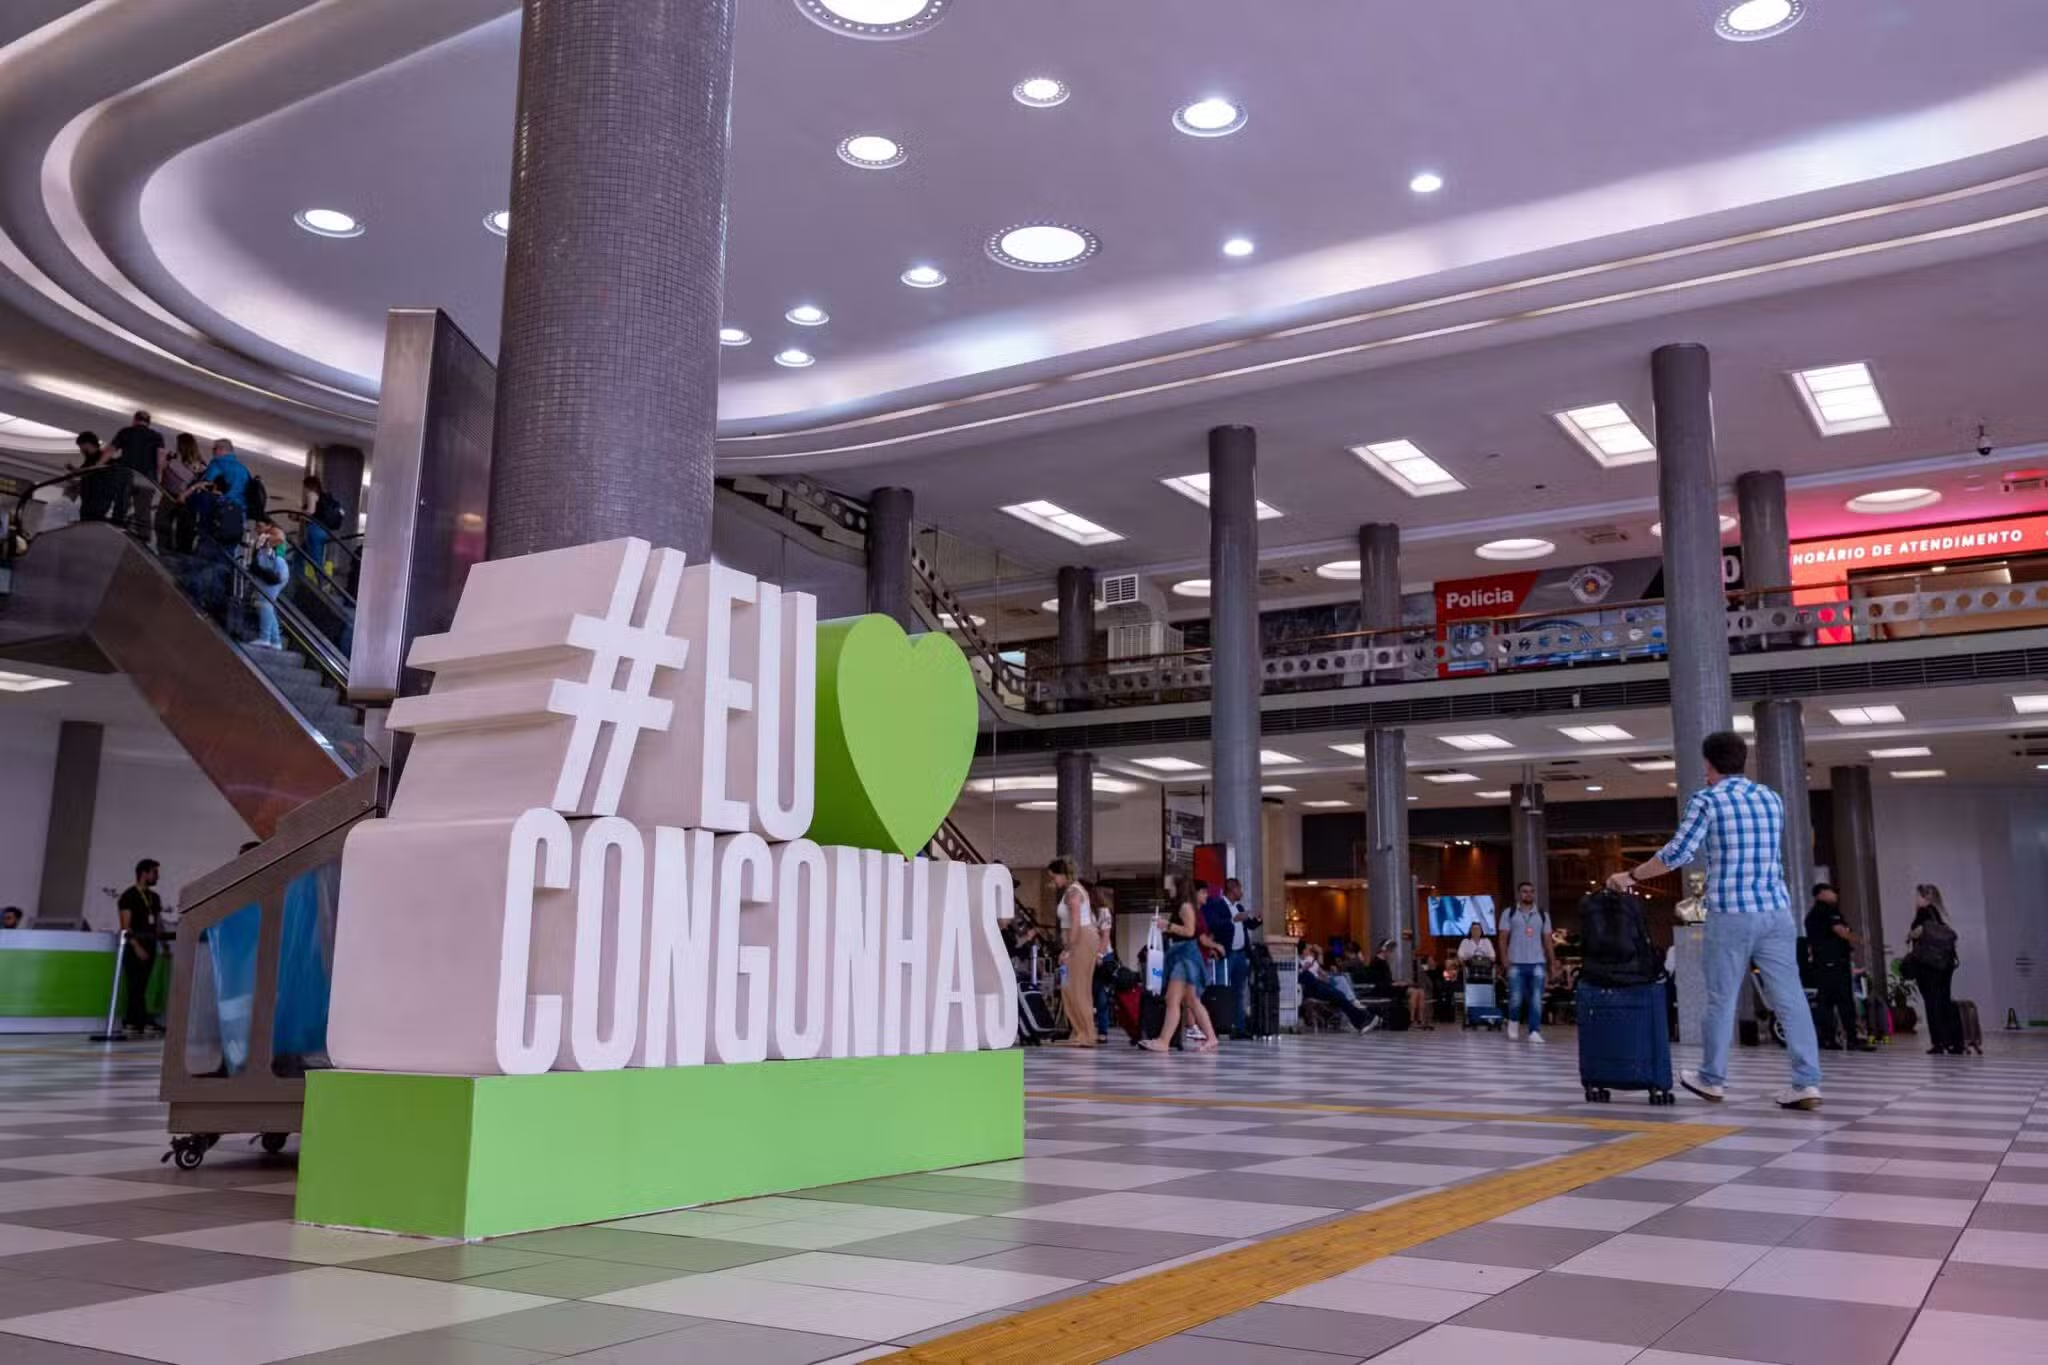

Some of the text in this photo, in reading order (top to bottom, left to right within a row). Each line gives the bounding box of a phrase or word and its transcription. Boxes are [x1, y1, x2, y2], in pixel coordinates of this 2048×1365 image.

[1446, 587, 1515, 609] Polícia
[1792, 530, 2024, 566] HORÁRIO DE ATENDIMENTO
[547, 537, 818, 841] #EU
[495, 807, 1019, 1076] CONGONHAS
